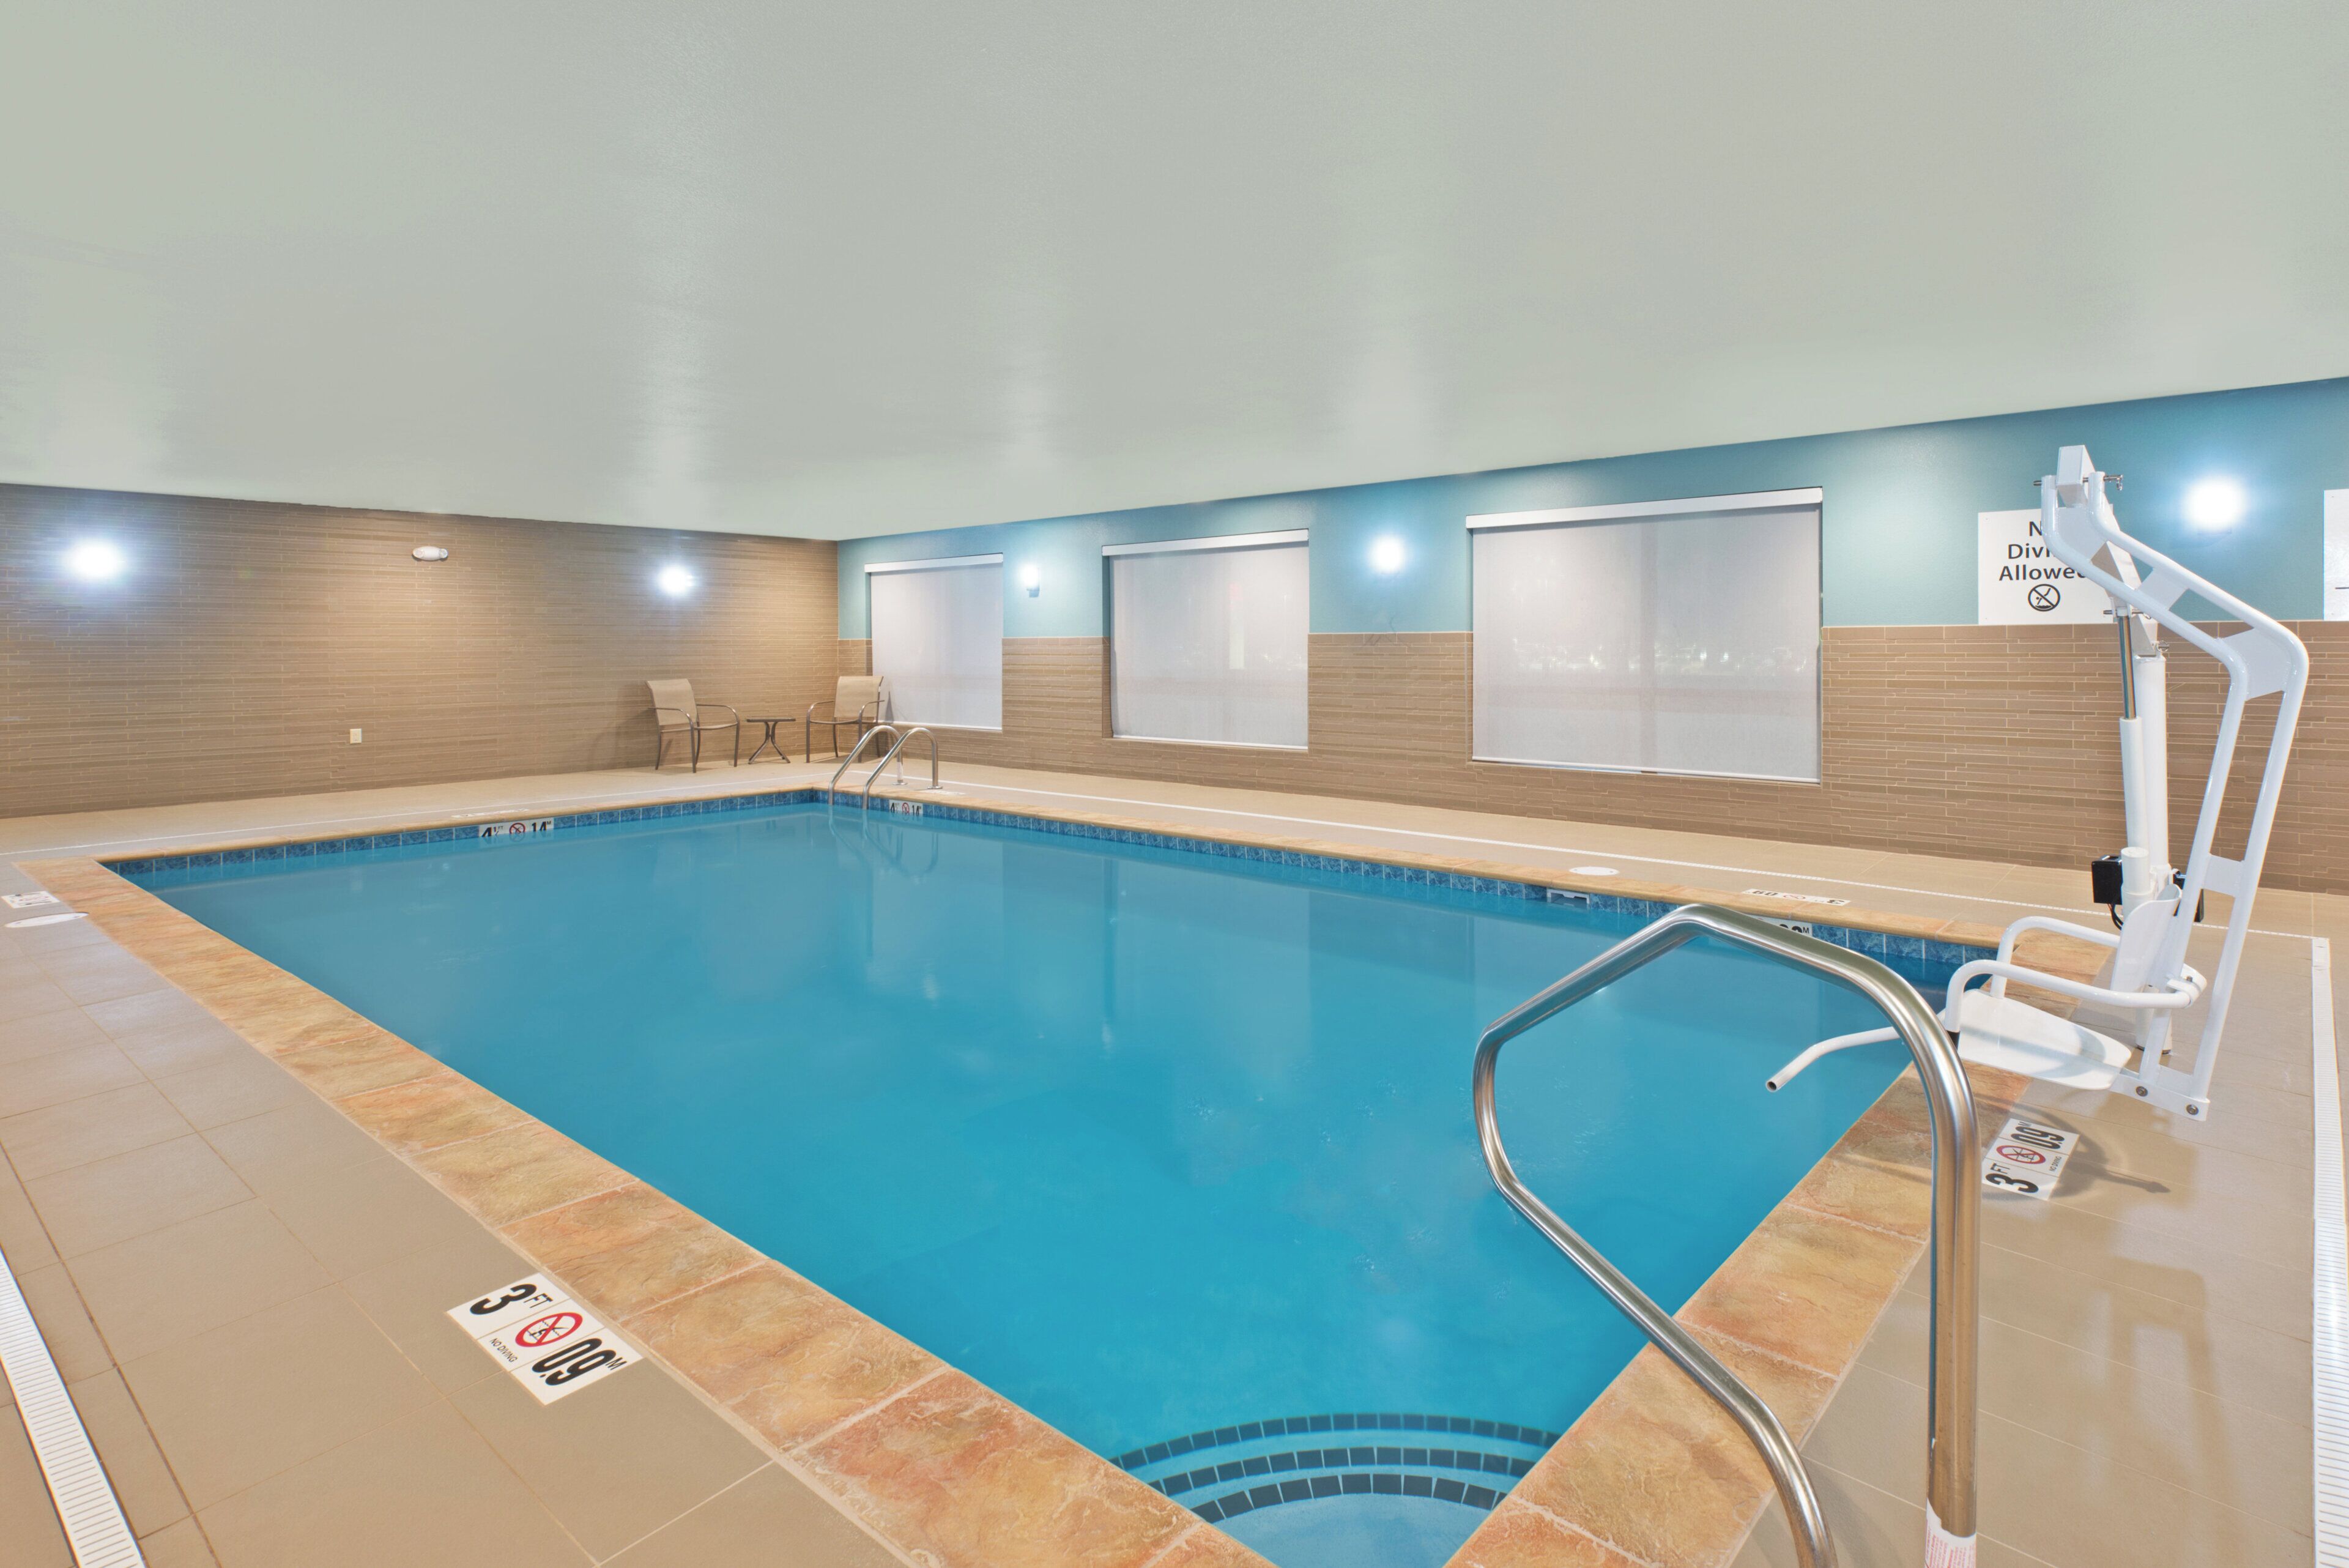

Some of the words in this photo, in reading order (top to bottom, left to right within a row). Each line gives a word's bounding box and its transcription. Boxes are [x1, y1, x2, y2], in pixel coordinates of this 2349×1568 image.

[2028, 521, 2042, 537] N
[2008, 543, 2054, 559] Divi
[1998, 564, 2086, 581] Allowe
[1990, 1162, 2011, 1175] FT
[1986, 1173, 2039, 1193] 3
[470, 1283, 537, 1315] 3
[523, 1293, 554, 1309] FT
[489, 1338, 502, 1347] NO
[497, 1345, 518, 1362] DIVING
[532, 1337, 617, 1386] 0.9
[605, 1356, 628, 1371] M
